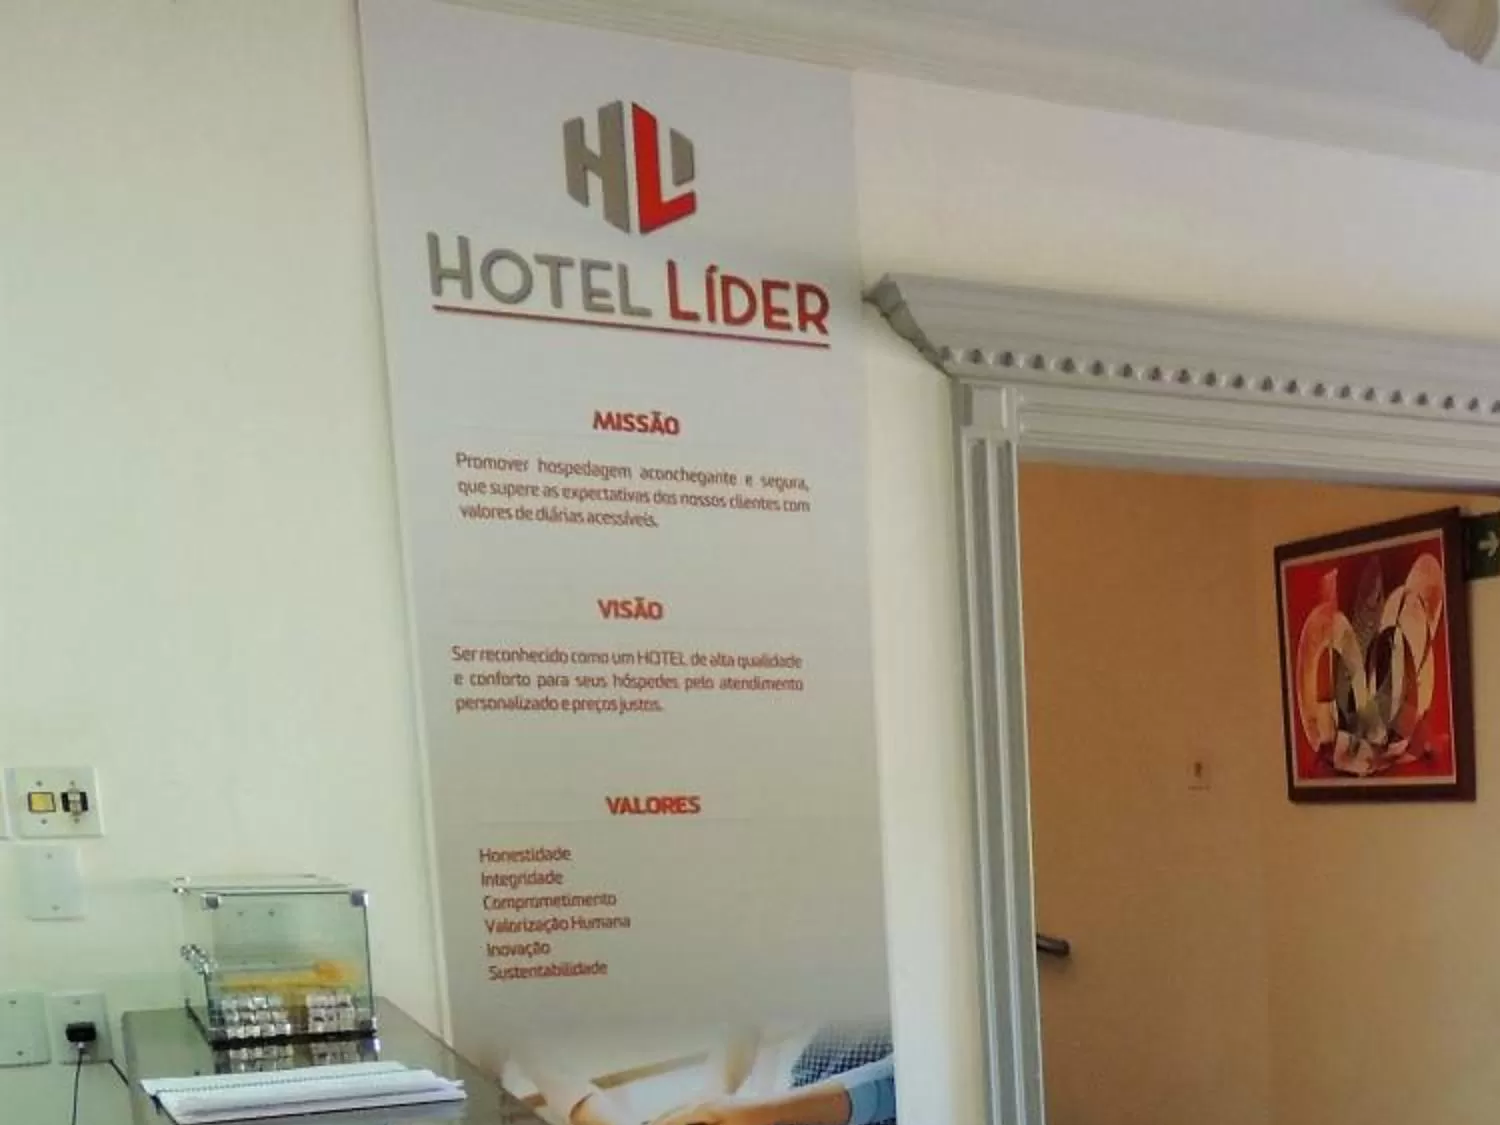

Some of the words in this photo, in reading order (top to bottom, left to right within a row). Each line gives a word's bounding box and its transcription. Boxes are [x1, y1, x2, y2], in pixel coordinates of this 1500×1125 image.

[427, 231, 651, 318] HOTEL
[666, 258, 830, 336] LÍDER
[592, 410, 680, 436] MISSÃO
[455, 451, 529, 473] Promover
[537, 457, 632, 481] hospedagem
[639, 465, 738, 487] aconchegante
[744, 474, 753, 487] e
[457, 480, 487, 496] que
[489, 482, 541, 499] supere
[542, 486, 560, 499] as
[561, 487, 650, 504] expectativas
[653, 489, 677, 506] dos
[680, 493, 727, 507] nossos
[729, 493, 781, 511] clientes
[783, 500, 811, 512] com
[459, 503, 512, 520] valores
[515, 505, 534, 520] de
[535, 505, 584, 524] diárias
[598, 595, 664, 621] VISÃO
[452, 645, 478, 662] Ser
[479, 647, 569, 665] reconhecido
[571, 651, 609, 664] como
[611, 653, 635, 665] um
[637, 650, 687, 667] HOTEL
[690, 652, 707, 666] de
[709, 652, 735, 668] alta
[737, 652, 803, 670] qualidade
[453, 673, 463, 686] e
[469, 670, 531, 687] conforto
[537, 674, 570, 690] para
[574, 675, 608, 688] seus
[613, 672, 679, 691] hóspedes
[684, 675, 714, 693] pelo
[718, 676, 804, 692] atendimento
[455, 696, 559, 714] personalizado
[561, 700, 571, 711] e
[572, 698, 619, 714] preços
[605, 795, 701, 816] VALORES
[479, 846, 572, 863] Honestidade
[481, 870, 564, 889] Integridade
[483, 892, 617, 912] Comprometimento
[484, 915, 569, 934] Valorização
[570, 915, 631, 931] Humana
[486, 941, 551, 958] Inovação
[488, 960, 608, 981] Sustentabilidade
